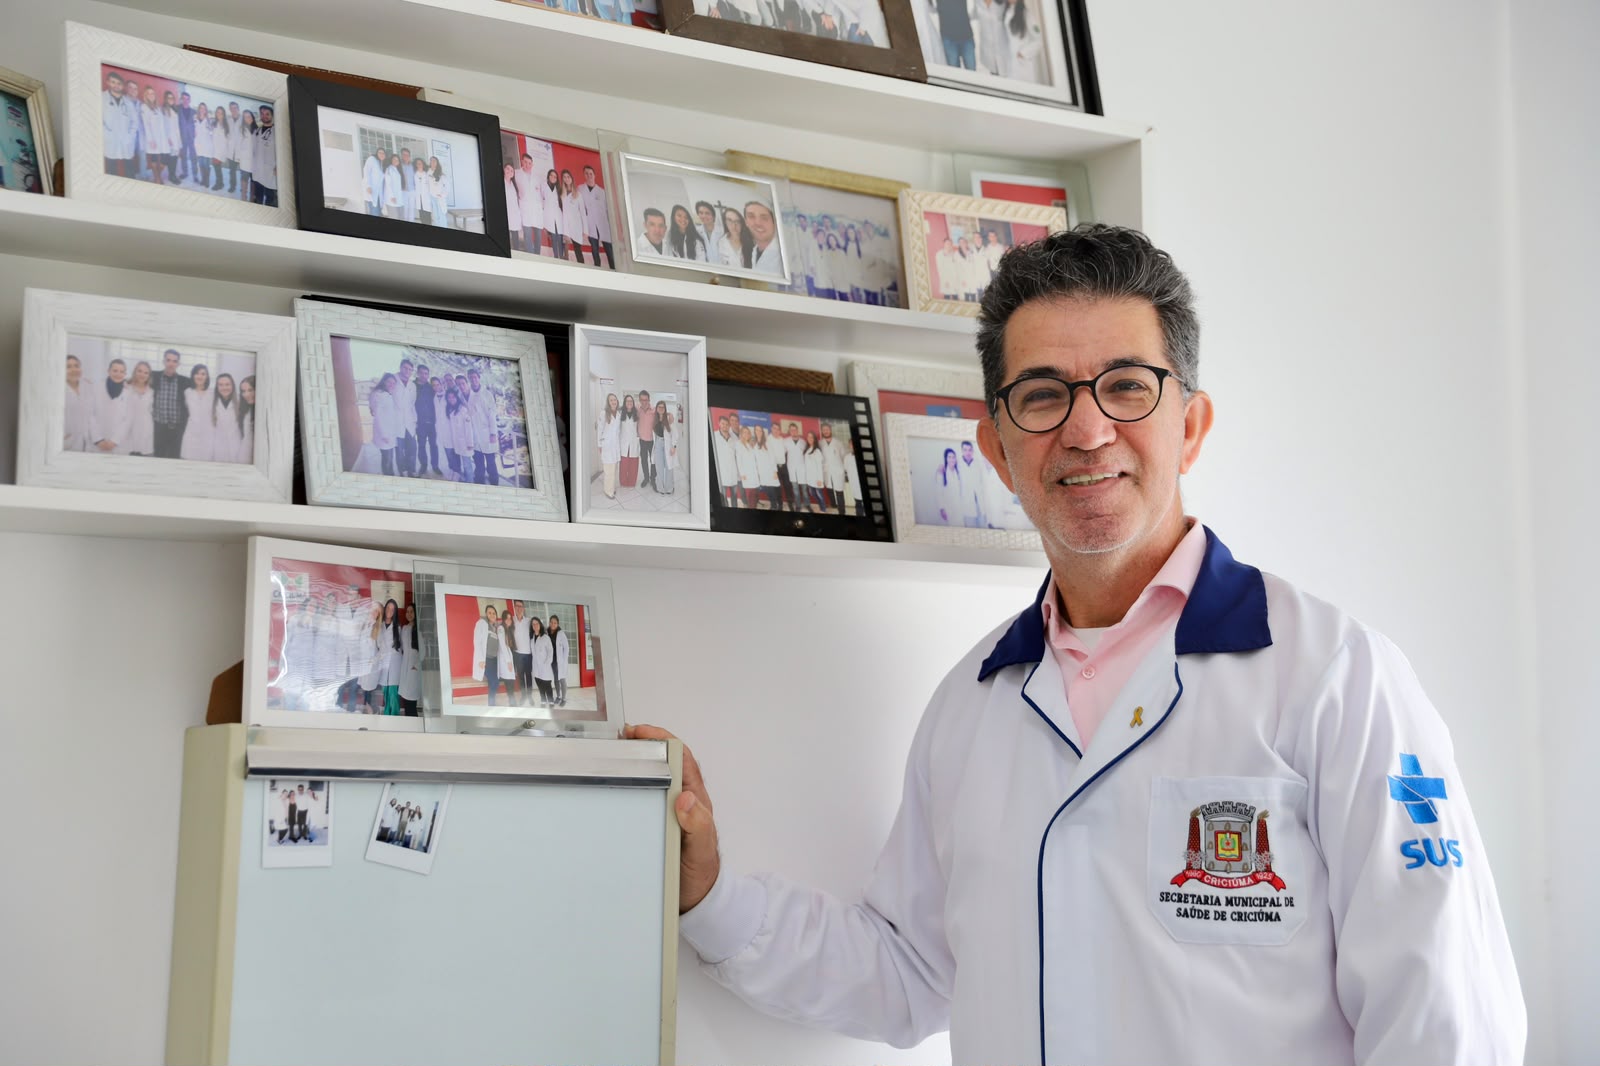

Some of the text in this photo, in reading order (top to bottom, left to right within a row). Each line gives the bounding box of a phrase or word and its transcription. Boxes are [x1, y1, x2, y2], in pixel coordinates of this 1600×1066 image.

[1400, 837, 1463, 870] SUS
[1203, 875, 1254, 887] CRICIÚMA
[1159, 891, 1295, 908] SECRETARIA MUNICIPAL DE
[1176, 906, 1282, 922] SAÚDE DE CRICIÚMA
